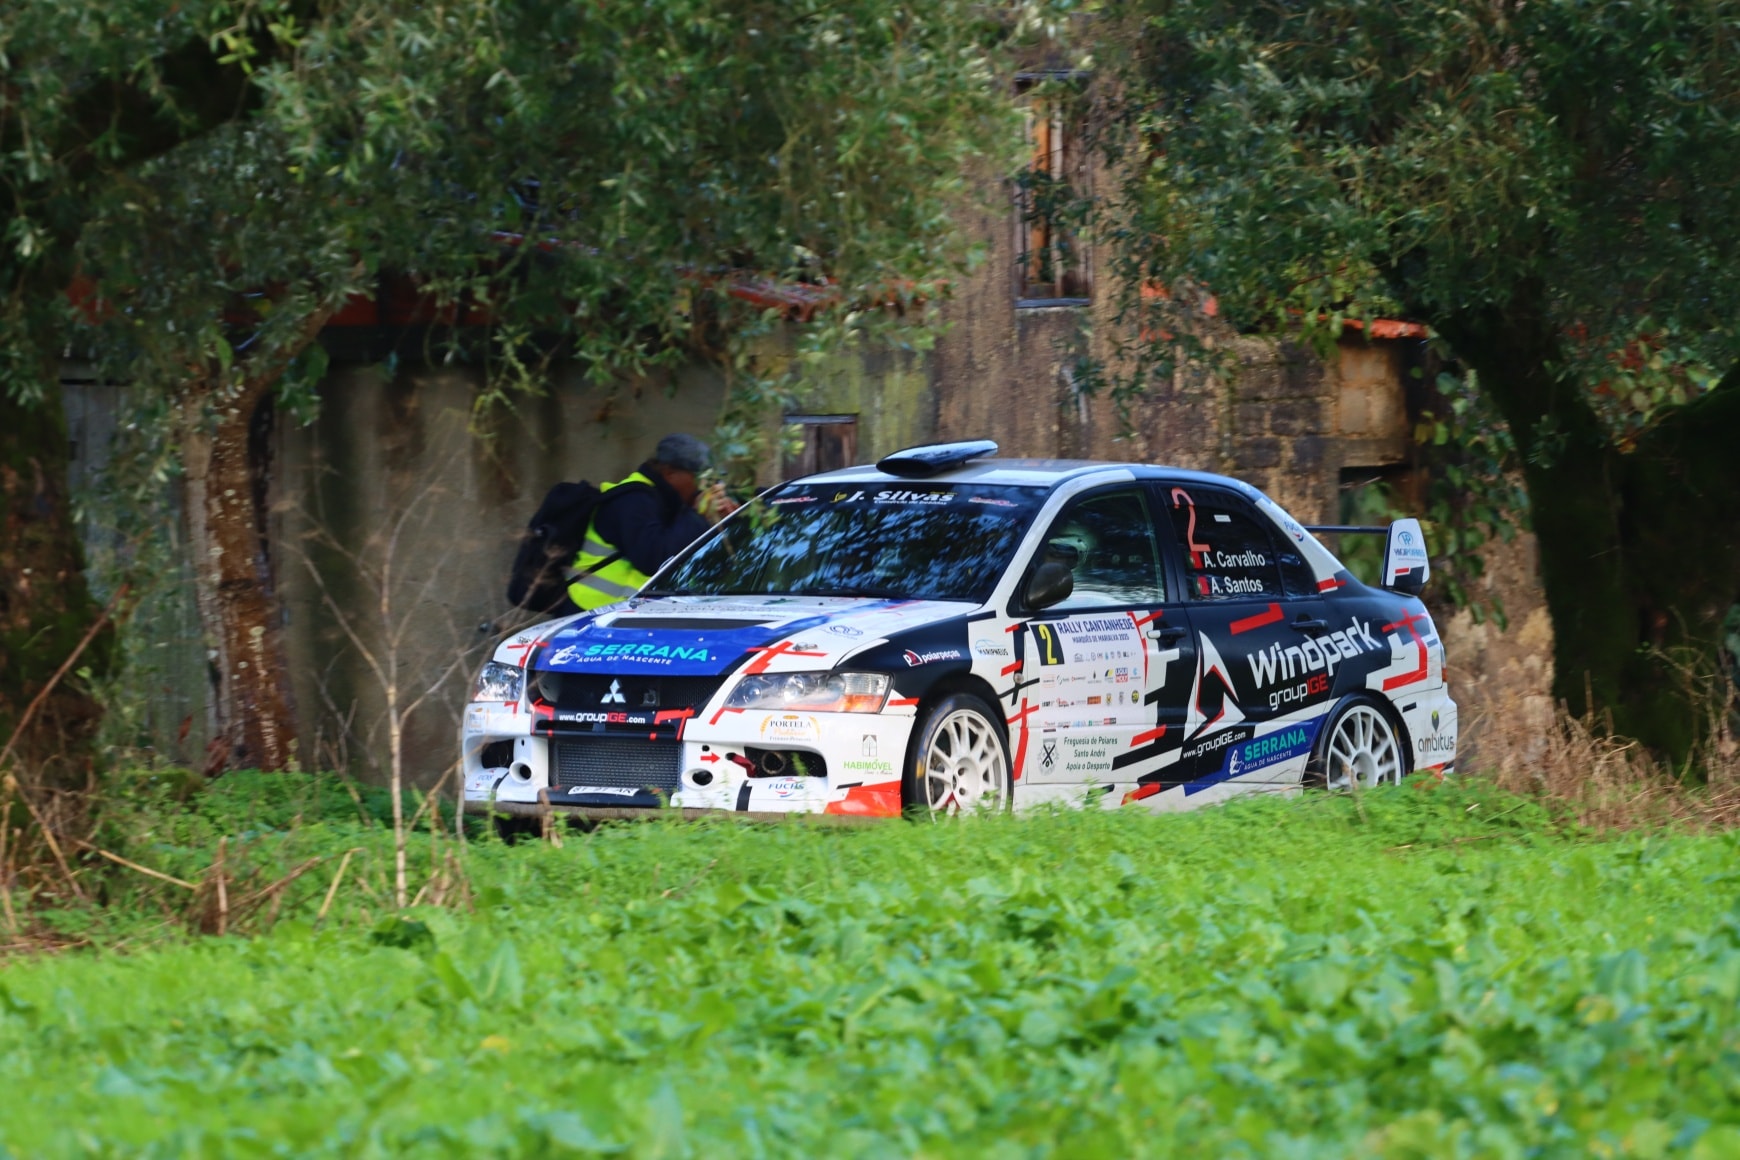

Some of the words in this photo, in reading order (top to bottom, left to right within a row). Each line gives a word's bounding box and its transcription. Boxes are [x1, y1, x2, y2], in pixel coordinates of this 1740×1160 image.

[873, 490, 955, 501] Silvas
[1171, 487, 1211, 552] 2
[1204, 553, 1217, 568] A.
[1217, 551, 1265, 568] Carvalho
[1211, 578, 1224, 594] A.
[1226, 576, 1263, 593] Santos
[1056, 621, 1083, 634] RALLY
[1084, 618, 1135, 632] CANTANHEDE
[1039, 624, 1057, 664] 2
[585, 643, 708, 662] SERRANA
[622, 655, 672, 665] NASCENTE
[1247, 616, 1382, 689] Windpark
[770, 720, 812, 728] PORTELA
[1064, 737, 1090, 747] Freguesia
[1098, 736, 1118, 744] Poiares
[1244, 728, 1307, 761] SERRANA
[1417, 733, 1455, 752] ambitus
[1073, 749, 1089, 758] Santo
[1089, 748, 1106, 757] André
[1266, 750, 1292, 762] NASCENTE
[843, 759, 893, 770] HABIMÓVEL
[1086, 761, 1111, 771] Desporto
